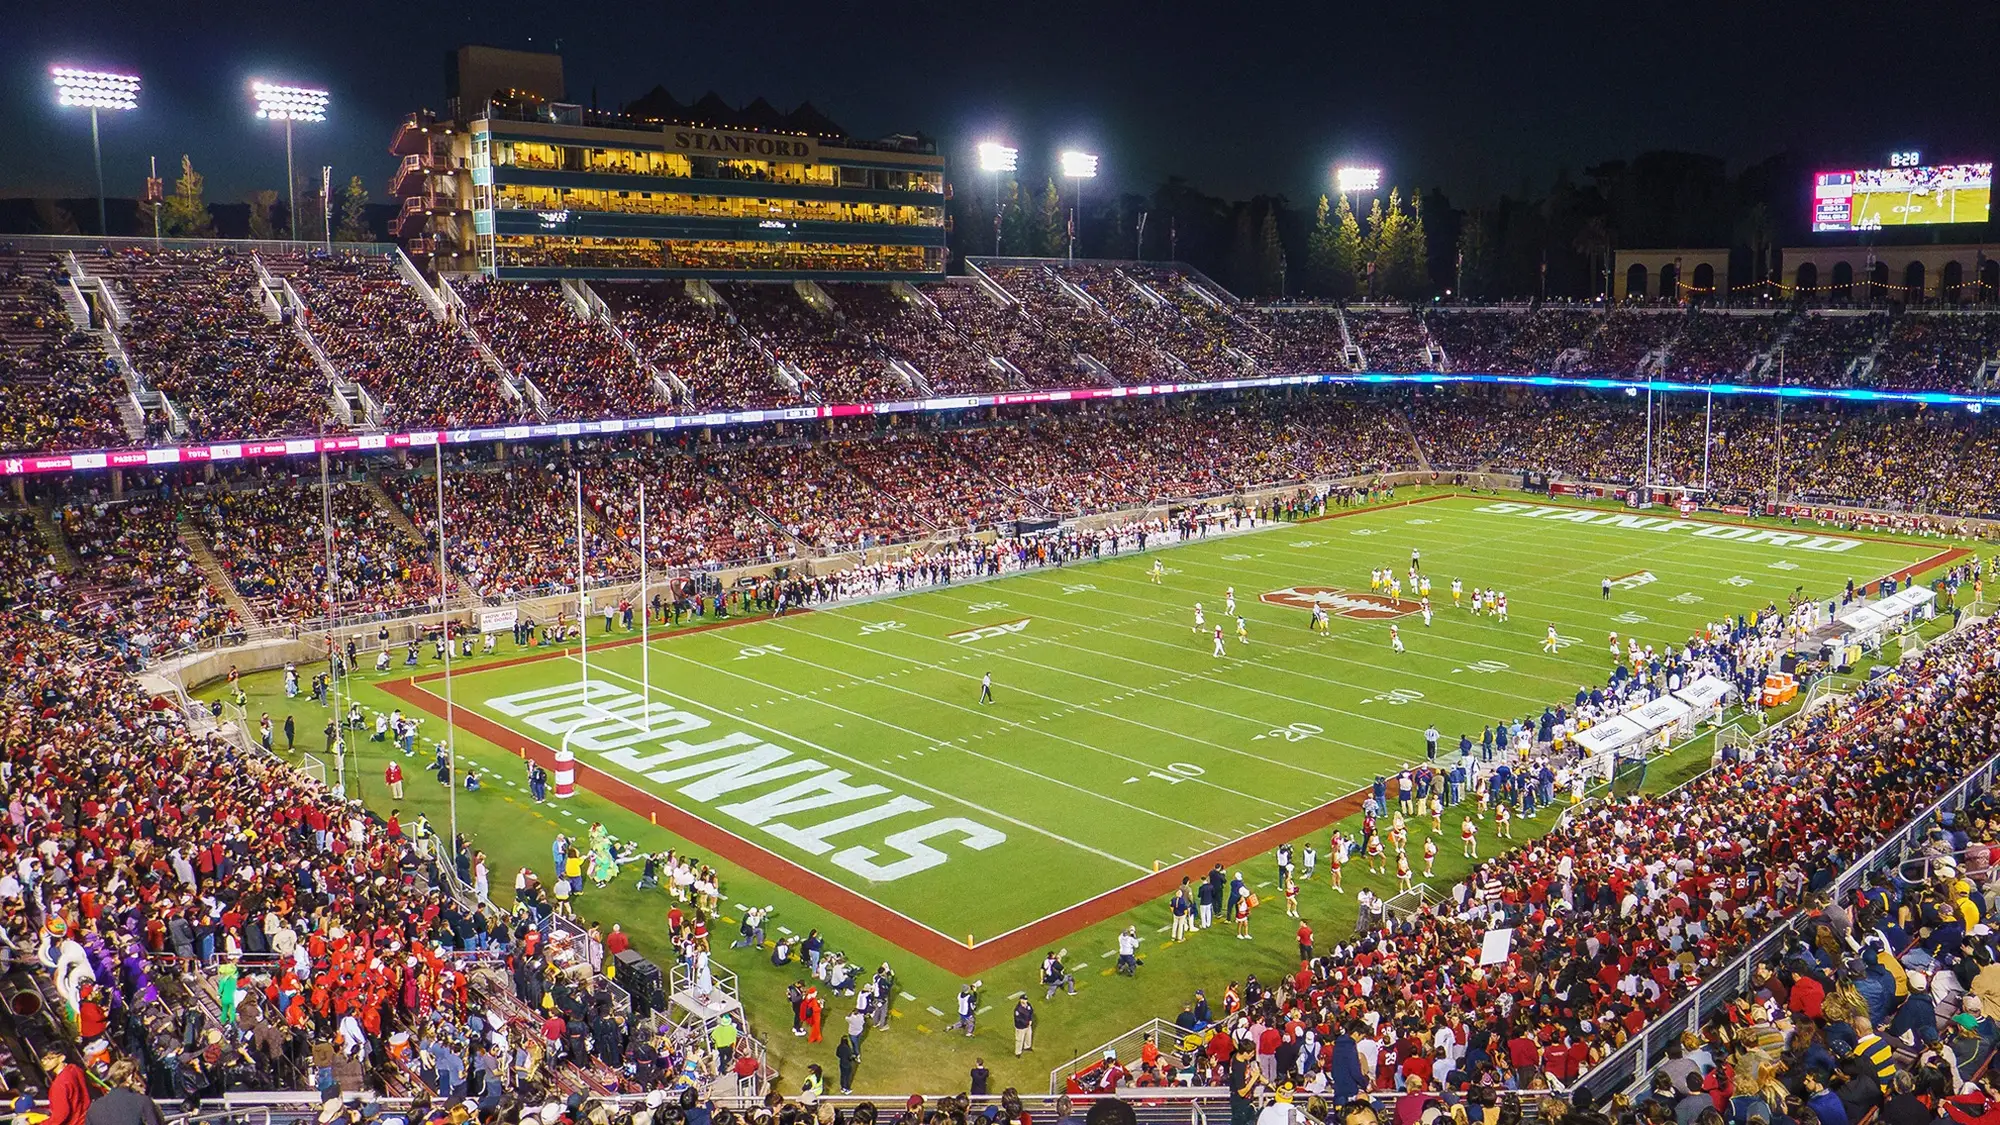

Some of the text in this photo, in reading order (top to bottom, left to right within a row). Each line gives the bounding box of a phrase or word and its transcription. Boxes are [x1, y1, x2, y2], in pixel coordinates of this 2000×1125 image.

[675, 132, 810, 157] STANFORD
[1891, 152, 1919, 167] 8:28
[113, 454, 146, 463] PASSING
[187, 450, 210, 458] TOTAL
[1474, 503, 1864, 552] STANFORD
[1374, 688, 1425, 705] 30
[1268, 722, 1324, 742] 20
[484, 679, 1007, 882] STANFORD
[1147, 762, 1206, 785] 10
[1736, 878, 1746, 889] 29
[1384, 1051, 1397, 1066] 29
